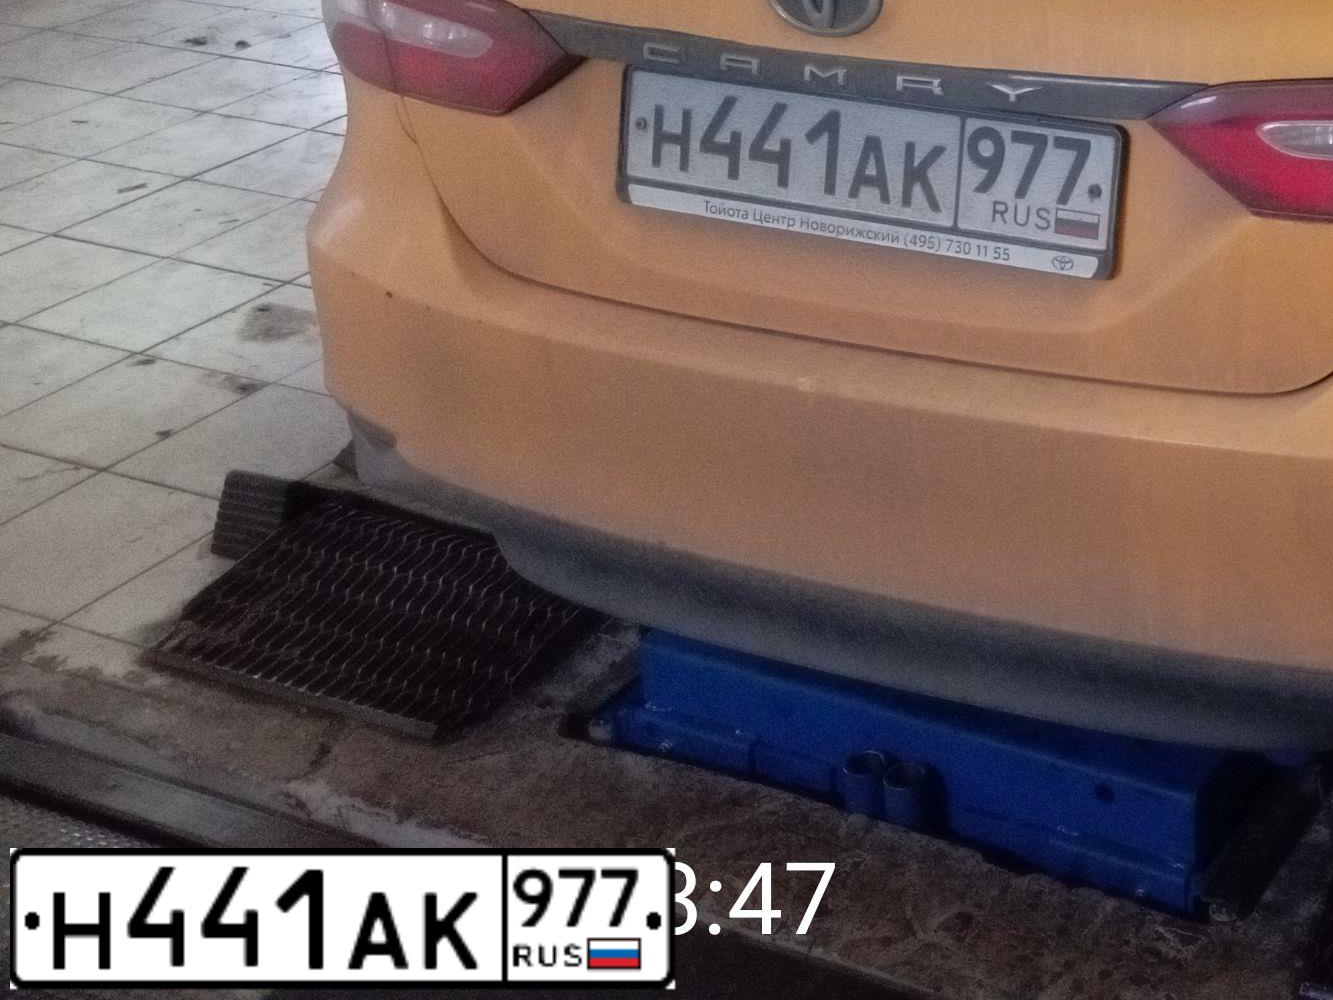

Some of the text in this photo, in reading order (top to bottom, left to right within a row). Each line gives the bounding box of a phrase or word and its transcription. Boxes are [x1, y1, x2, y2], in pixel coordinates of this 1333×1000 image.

[641, 41, 1045, 102] CAMRY
[650, 95, 1092, 214] Н441АК 977
[704, 199, 1011, 262] Тойота Центр Новорижский (495) 730 11 55
[991, 201, 1051, 231] RUS
